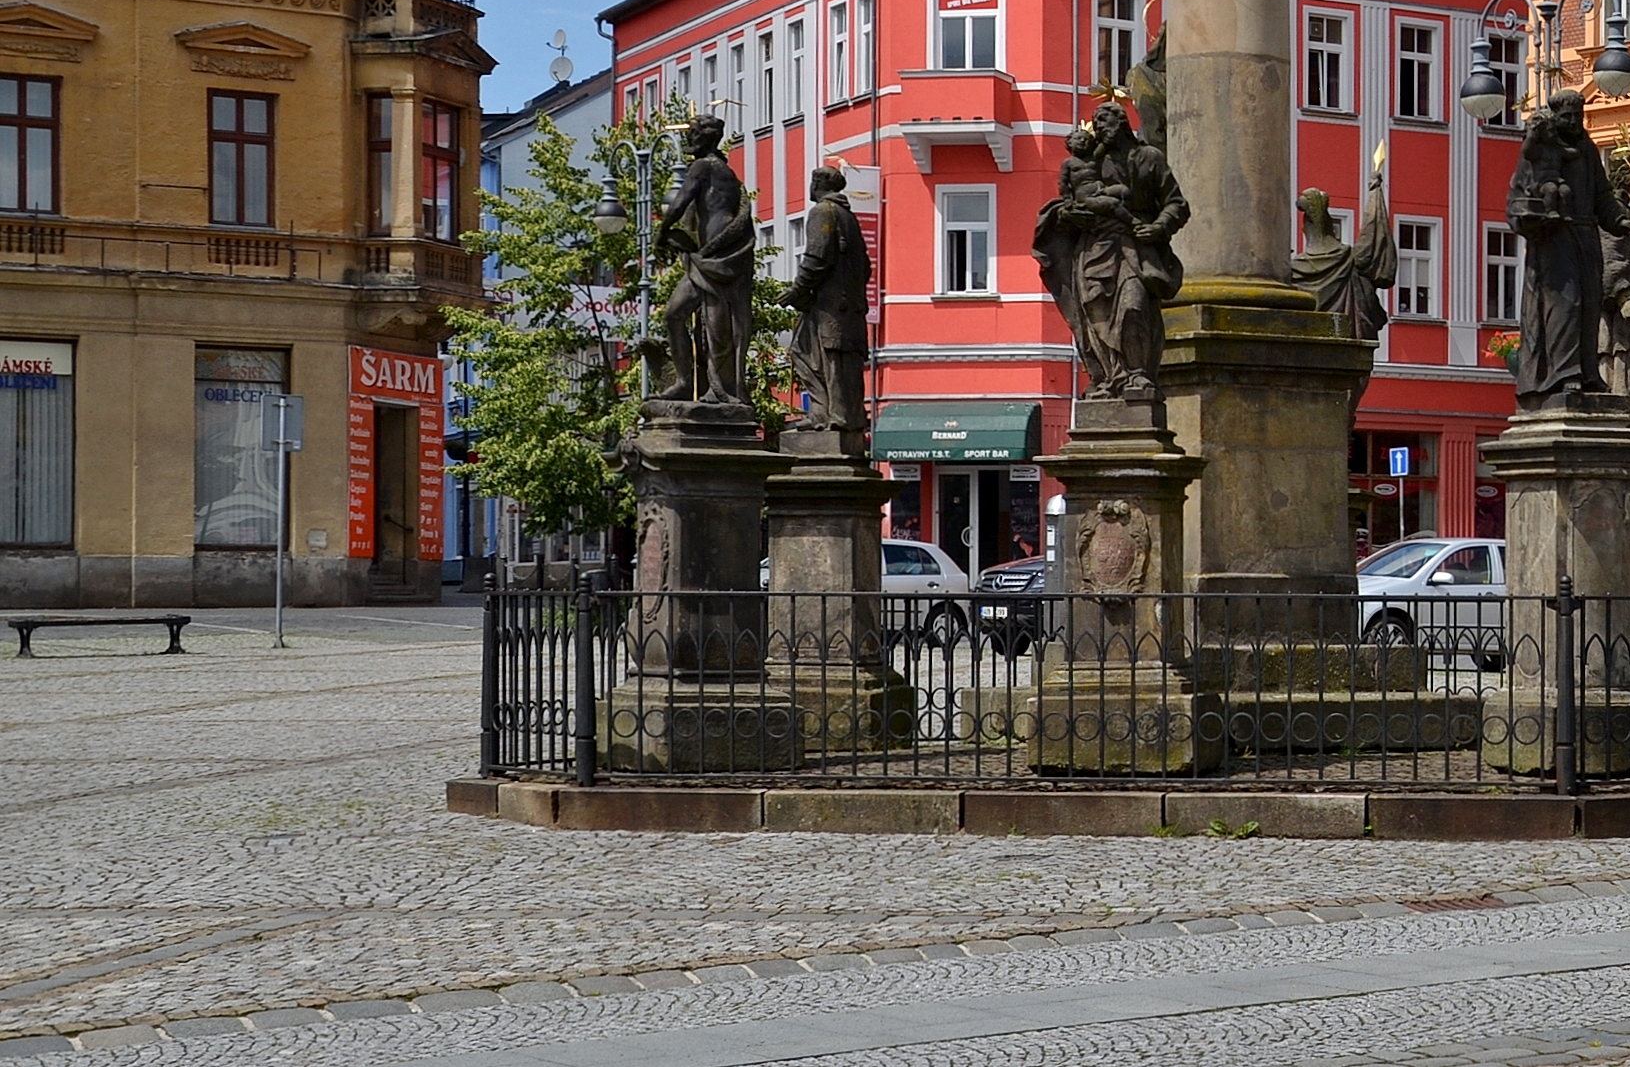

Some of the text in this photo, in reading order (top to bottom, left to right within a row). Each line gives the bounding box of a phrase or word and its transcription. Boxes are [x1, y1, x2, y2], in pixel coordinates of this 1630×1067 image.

[0, 355, 53, 374] ÁMSKÉ
[360, 349, 436, 394] ŠARM
[204, 386, 273, 403] OBLEČEN
[931, 431, 967, 440] BERNARD
[887, 450, 1009, 459] POTRAVINY T.S.T. SPORT BAR
